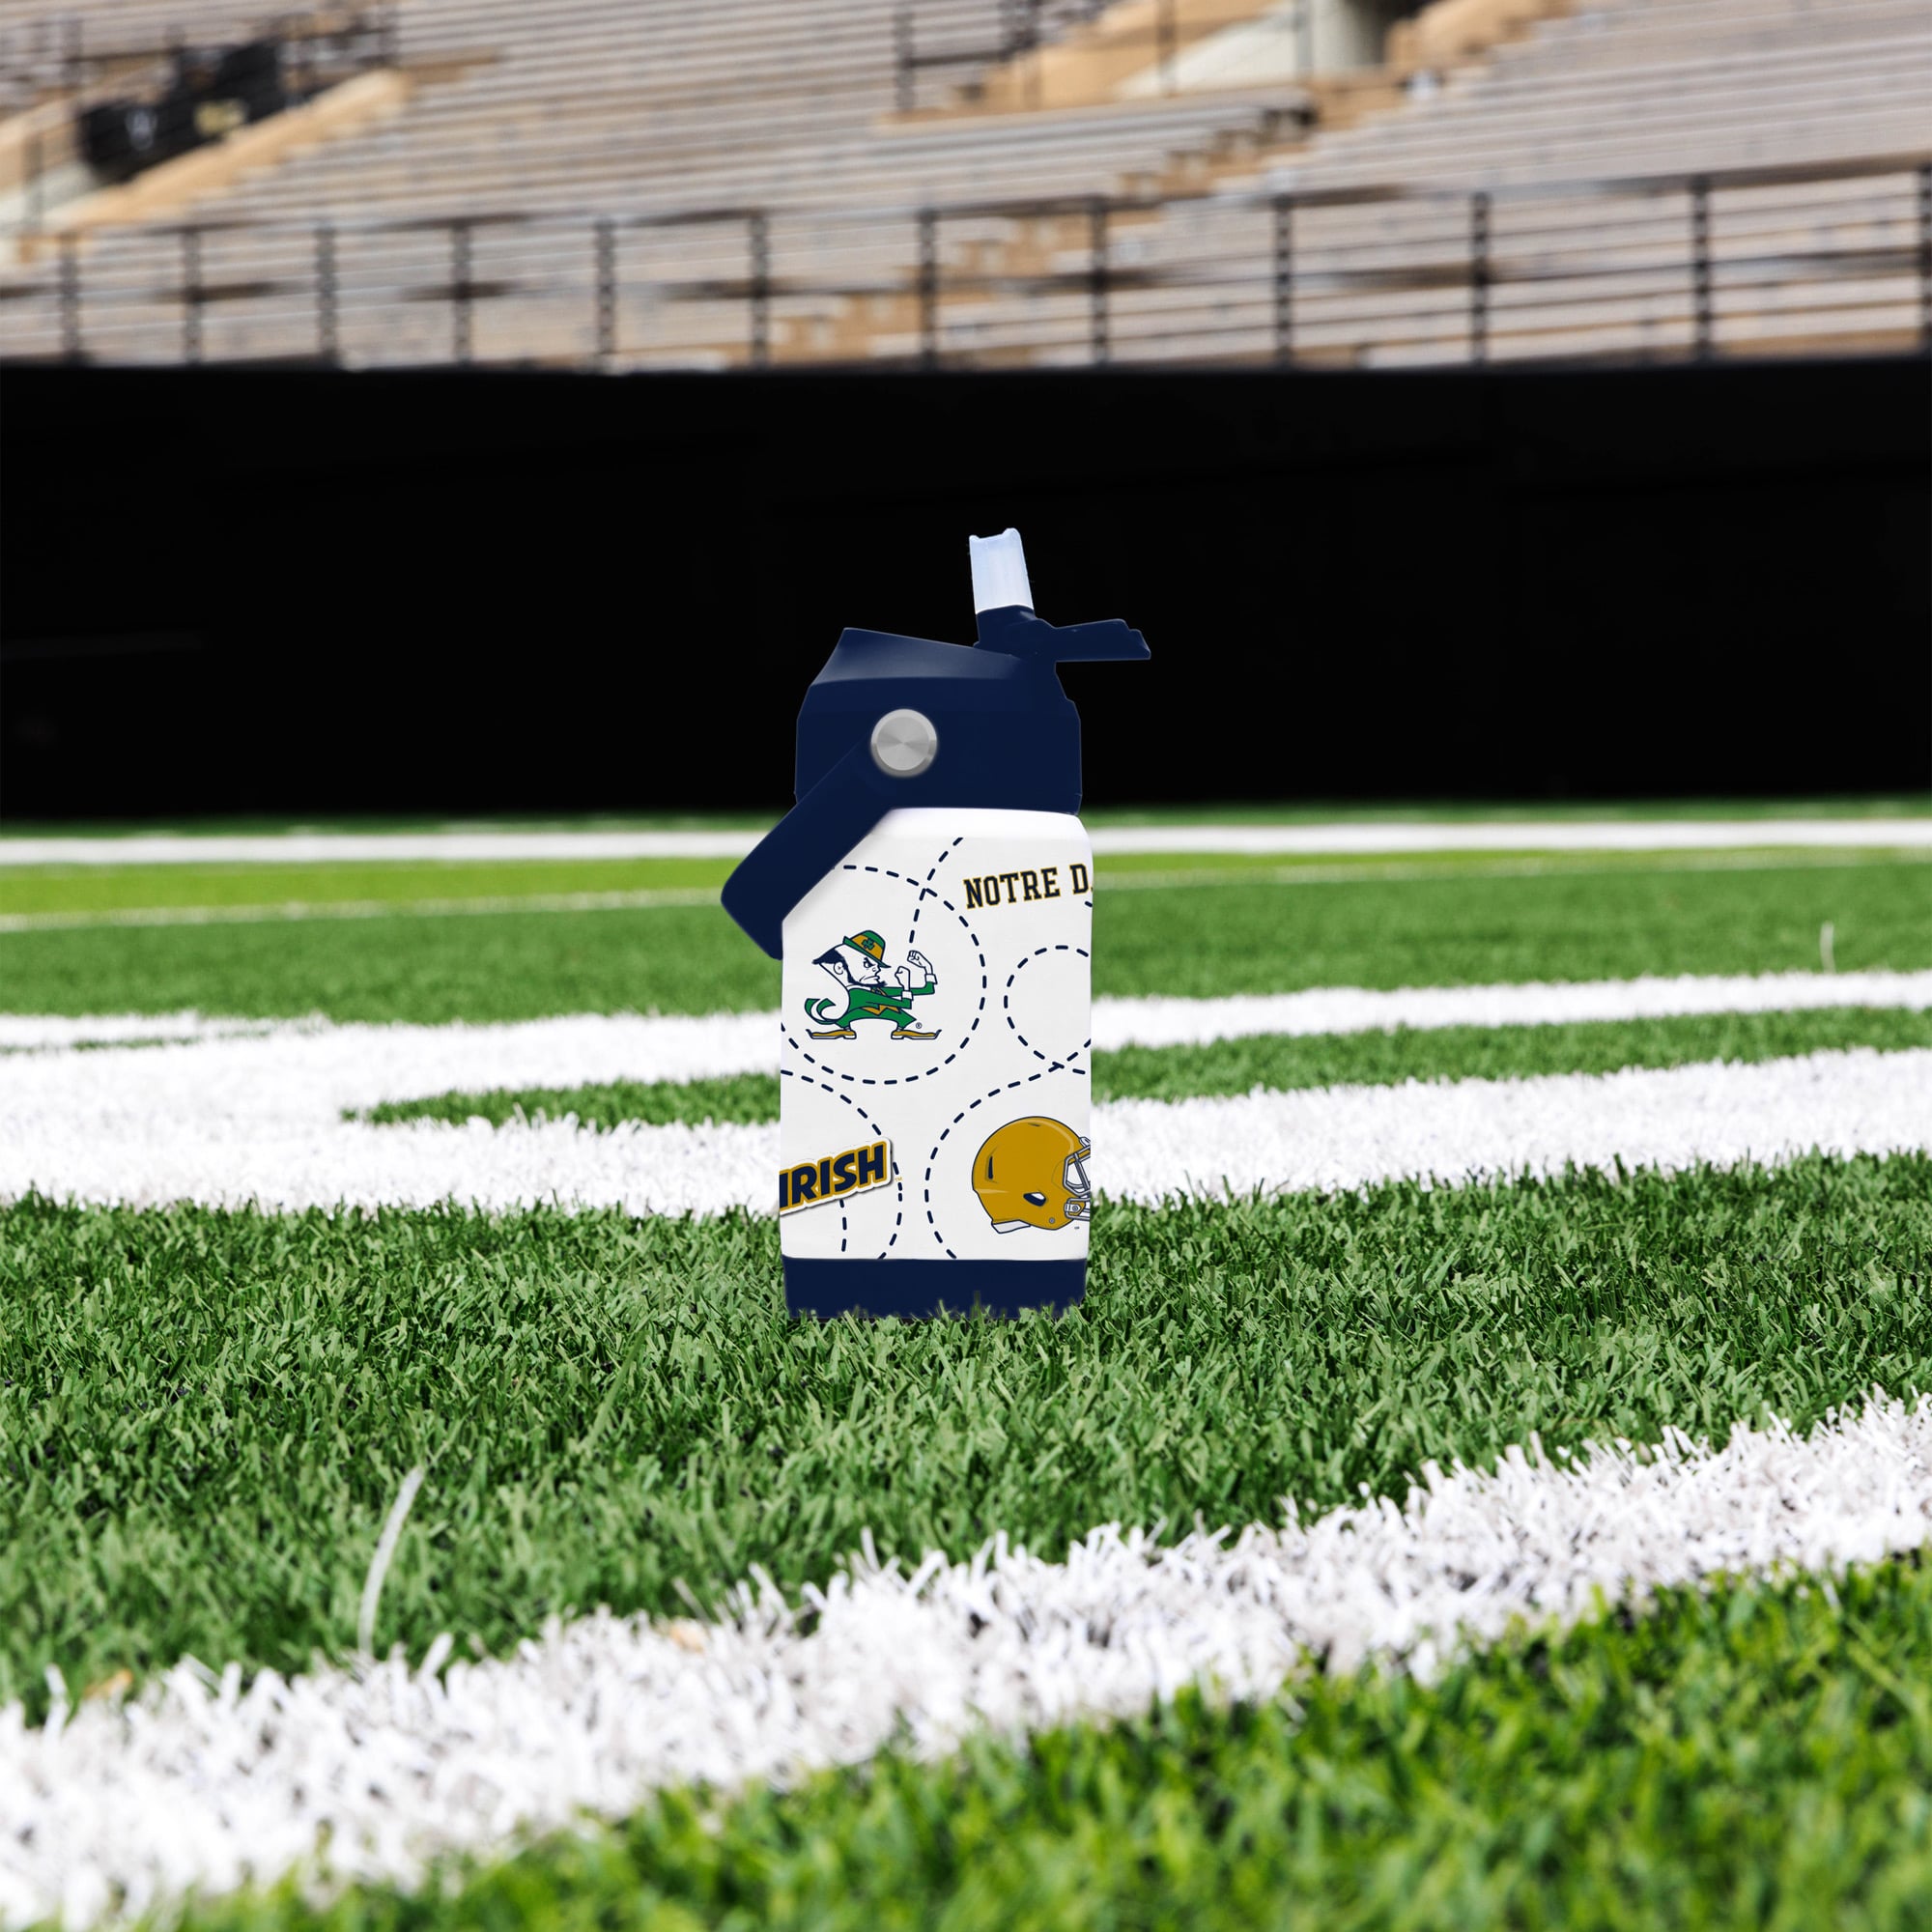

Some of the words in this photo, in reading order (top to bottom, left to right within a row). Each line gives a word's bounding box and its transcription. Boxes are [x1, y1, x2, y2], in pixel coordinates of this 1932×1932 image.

[963, 867, 1061, 909] NOTRE
[1069, 863, 1093, 895] D
[780, 1141, 887, 1211] IRISH
